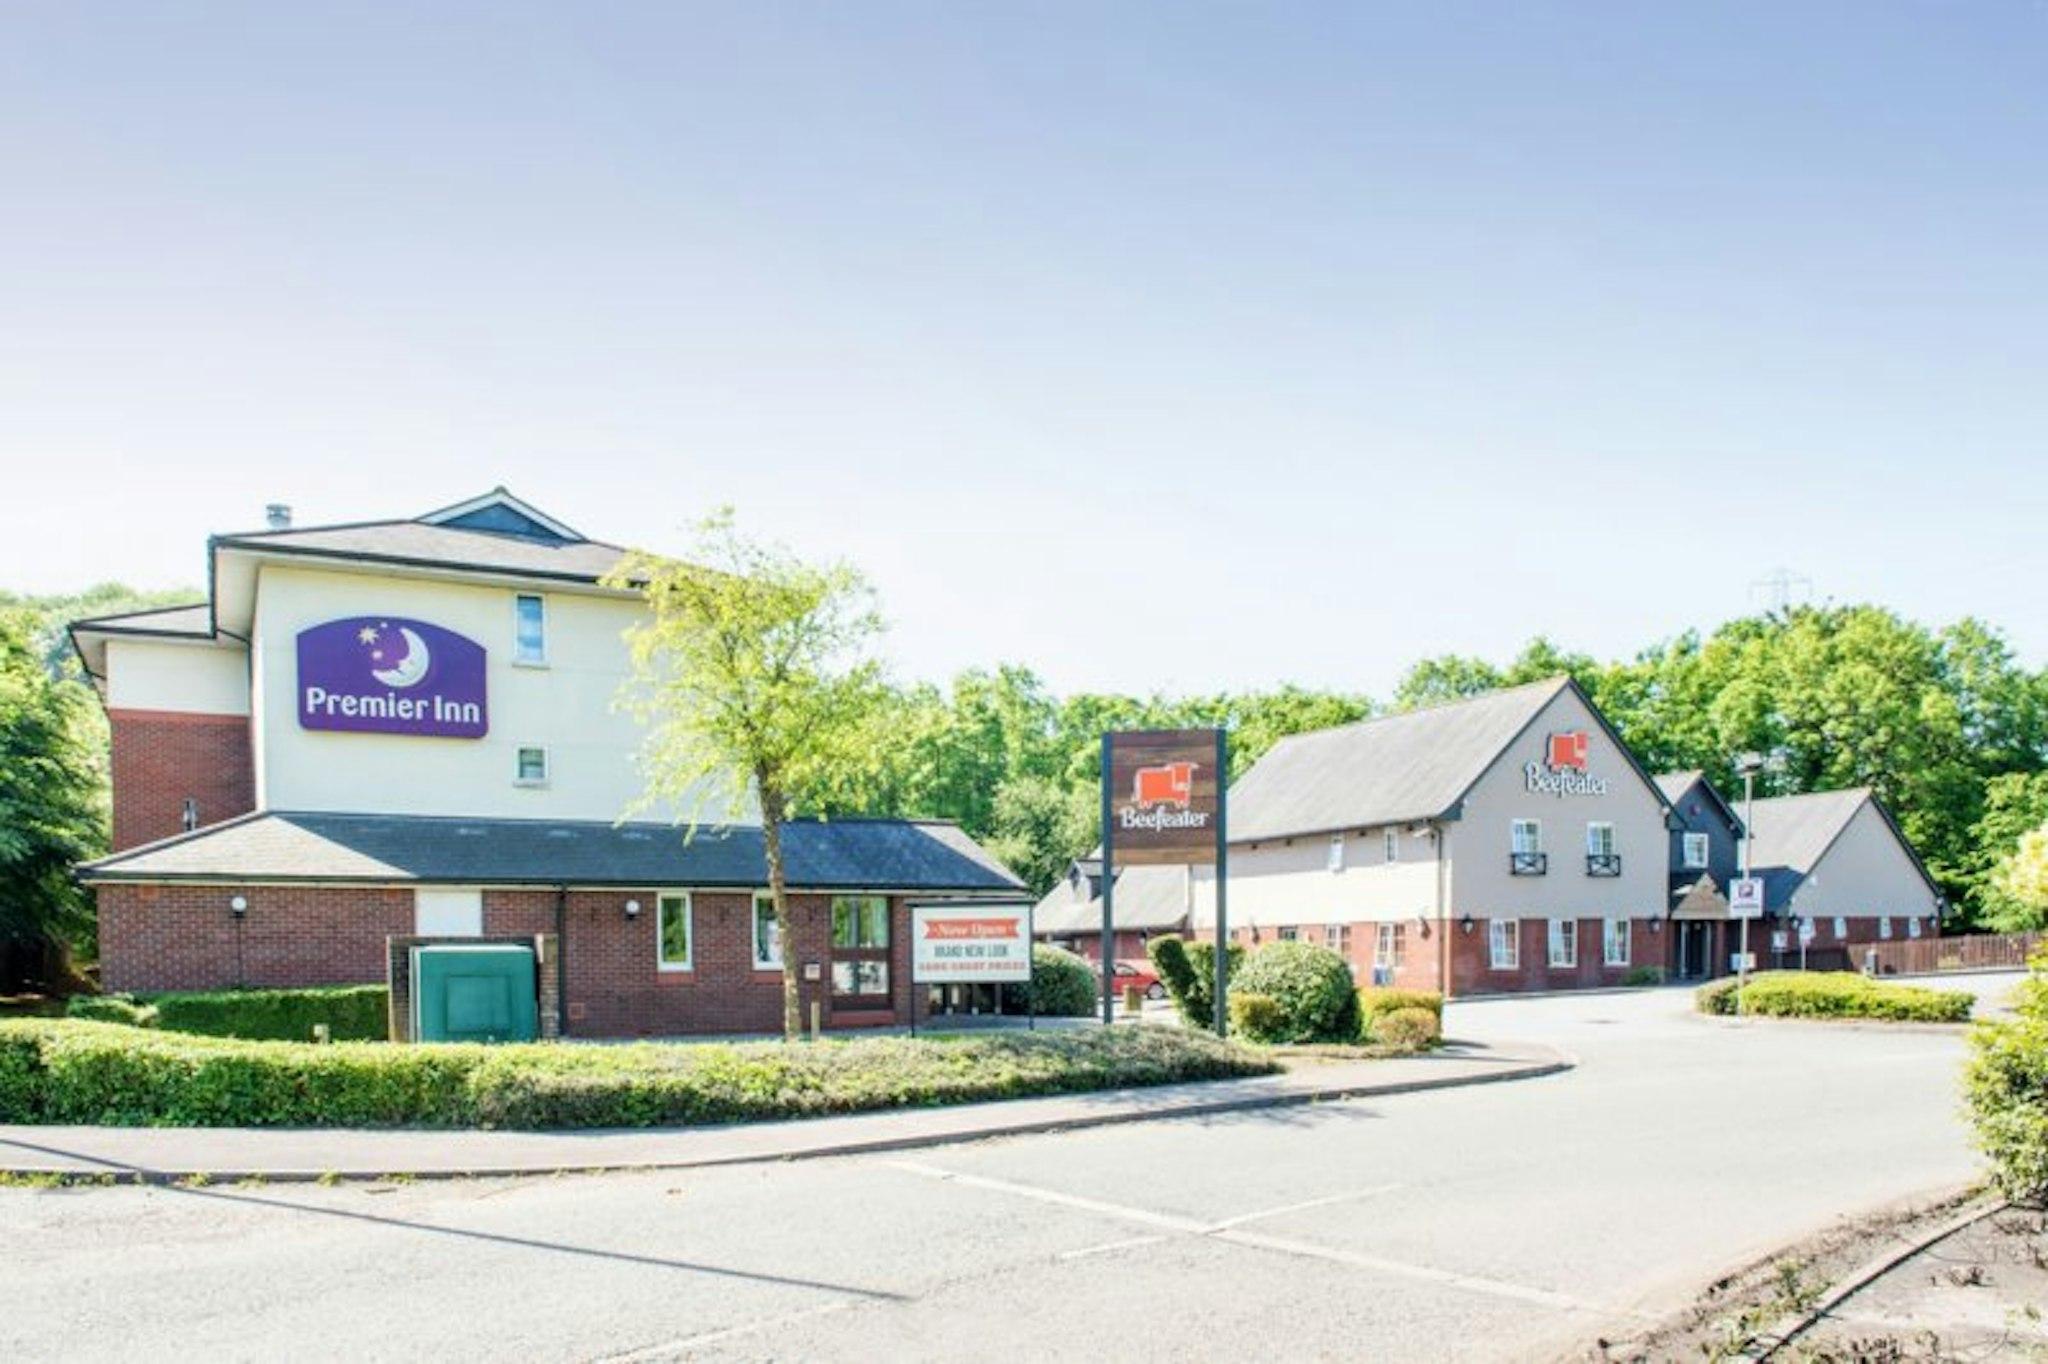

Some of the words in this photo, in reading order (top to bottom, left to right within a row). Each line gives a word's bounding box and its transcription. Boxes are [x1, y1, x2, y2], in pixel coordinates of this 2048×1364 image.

[306, 687, 429, 720] Premier
[434, 695, 480, 723] Inn
[1523, 761, 1608, 798] Beefeater
[1119, 805, 1209, 832] Beefeater
